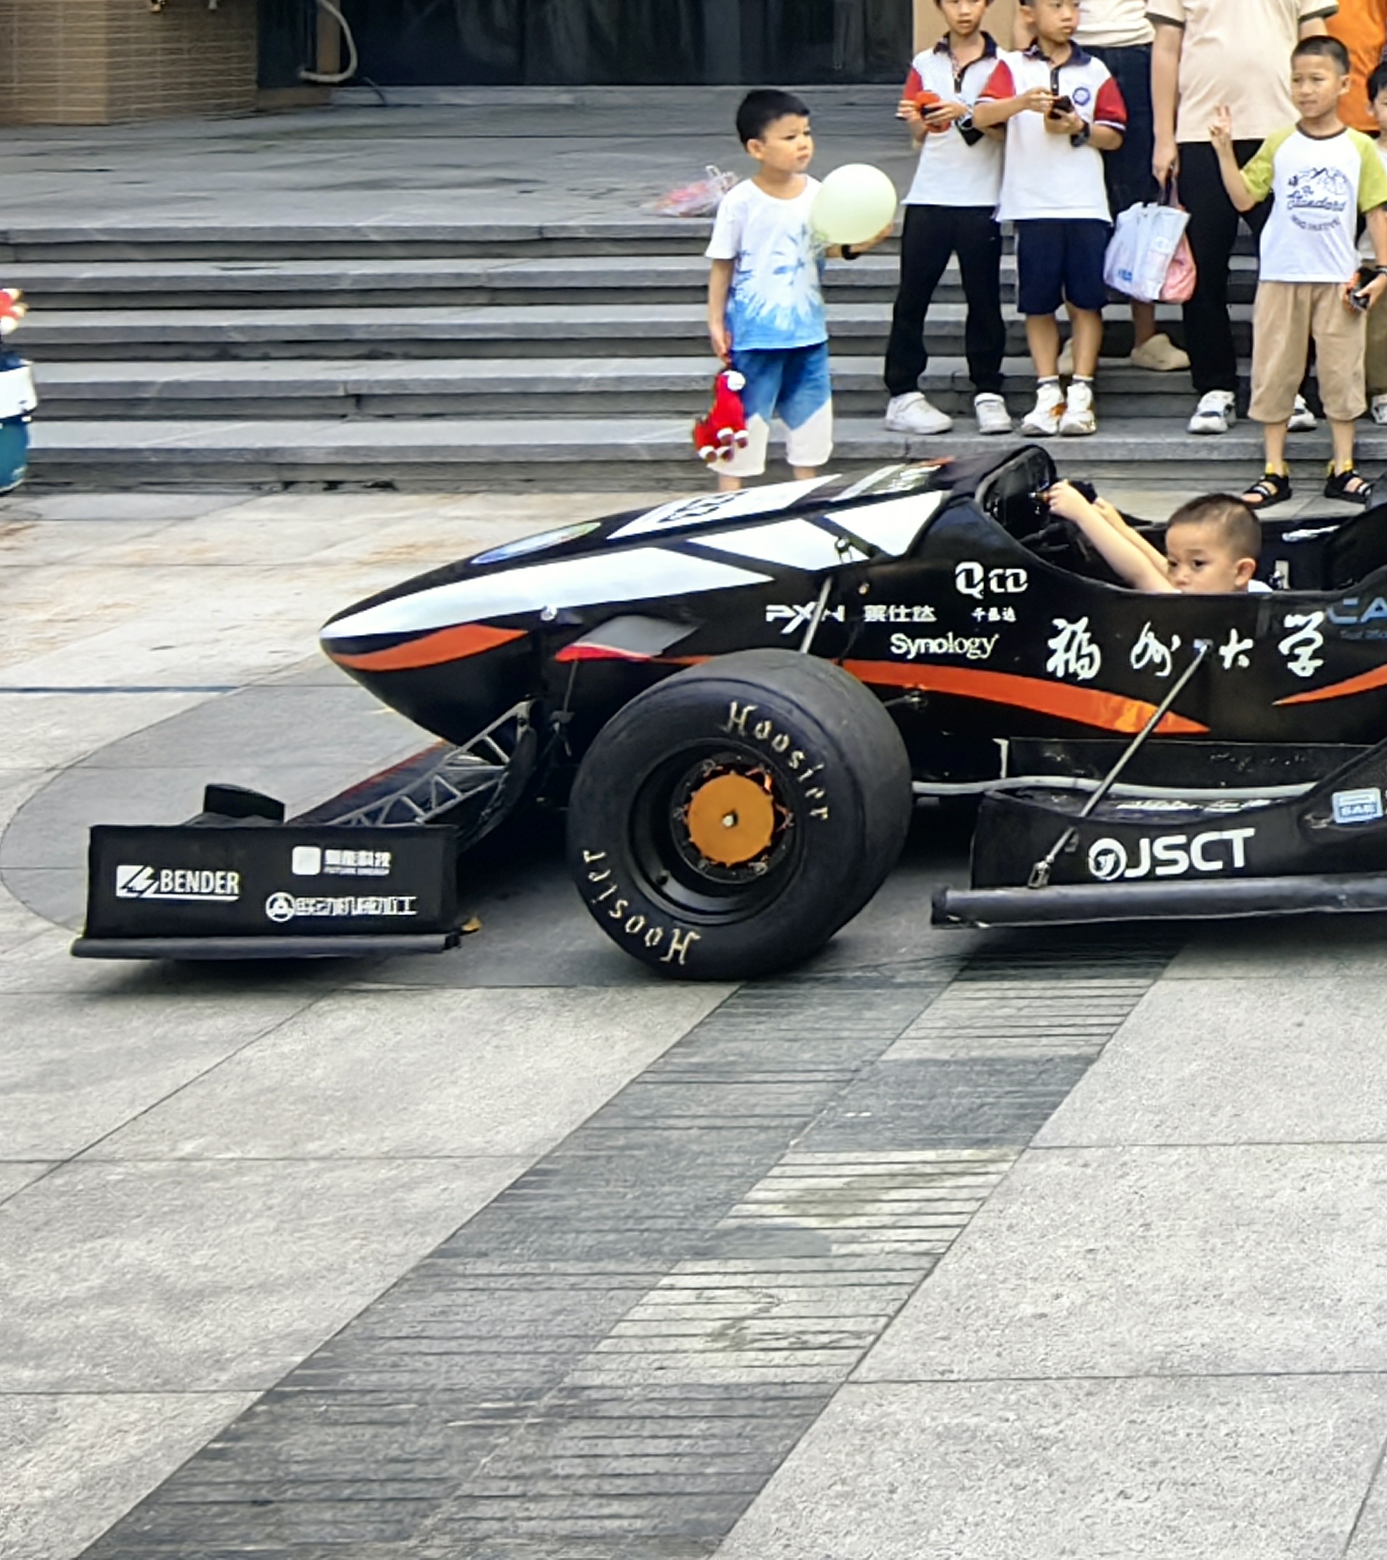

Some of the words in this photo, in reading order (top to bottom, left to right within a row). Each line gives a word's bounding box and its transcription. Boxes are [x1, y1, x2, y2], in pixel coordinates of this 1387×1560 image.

[765, 602, 845, 634] PXN
[890, 632, 999, 660] Synology
[1046, 611, 1325, 678] 福州大学
[726, 700, 831, 822] Hoosier
[1124, 827, 1256, 879] JSCT
[160, 869, 239, 894] BENDER
